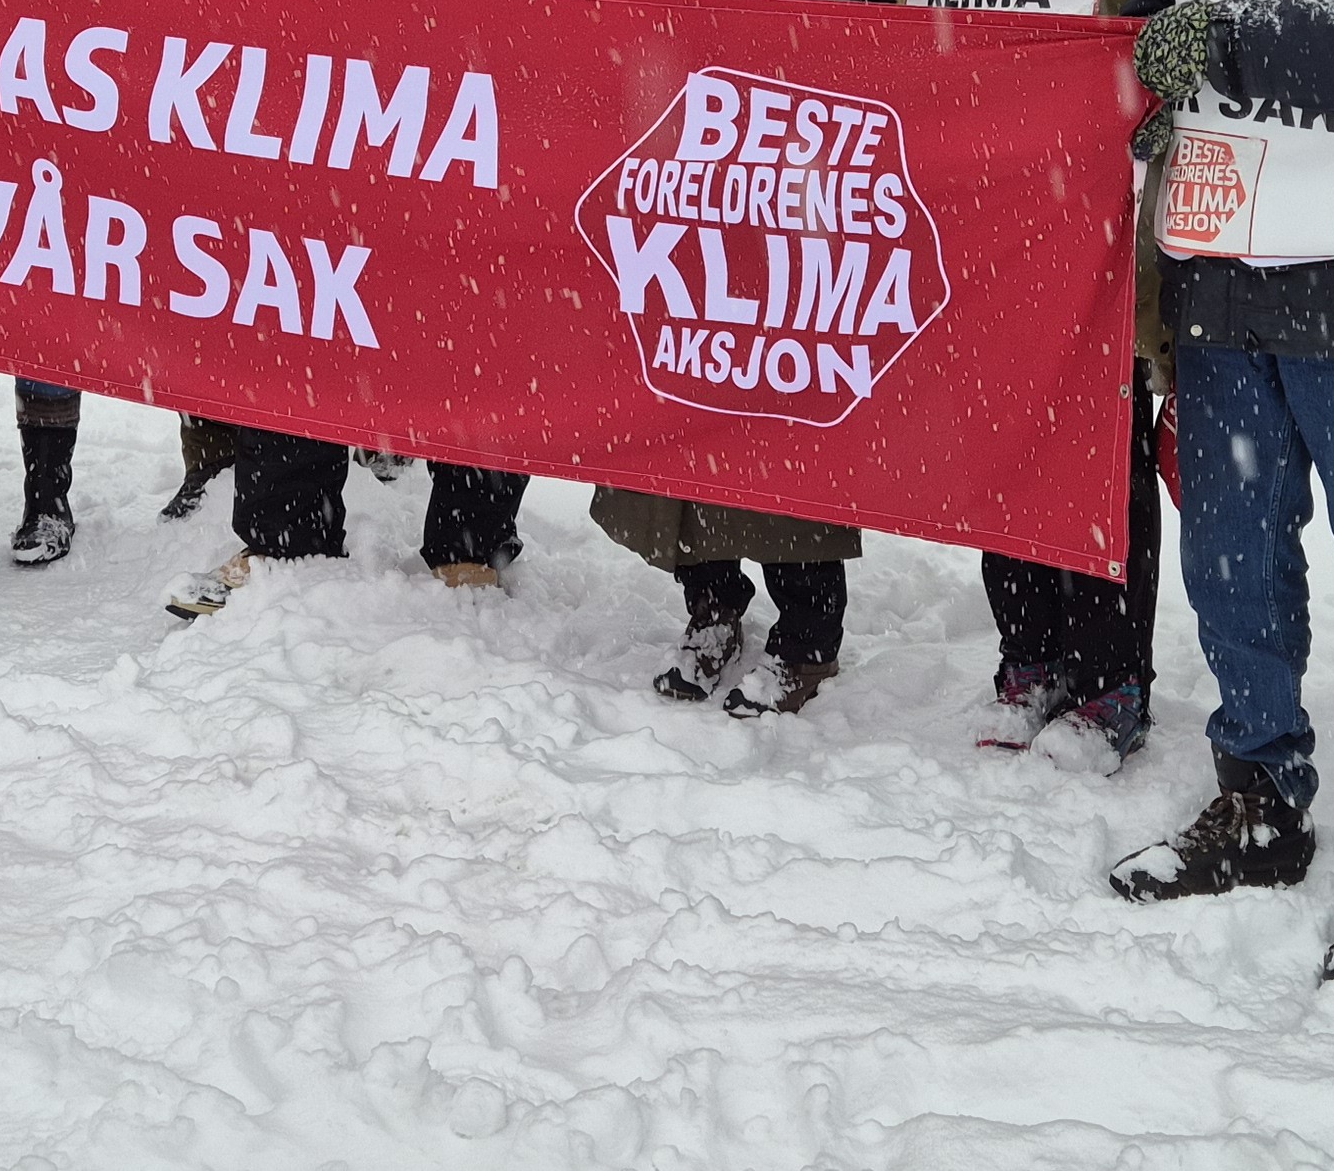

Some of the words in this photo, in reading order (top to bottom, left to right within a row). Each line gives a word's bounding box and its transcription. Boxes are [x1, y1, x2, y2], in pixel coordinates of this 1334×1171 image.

[148, 35, 499, 189] KLIMA
[675, 71, 888, 167] BESTE
[1177, 139, 1227, 165] BESTE
[616, 157, 908, 239] FORELDRENES
[1166, 181, 1239, 213] KLIMA
[169, 214, 381, 349] SAK
[605, 214, 920, 336] KLIMA
[652, 325, 873, 399] AKSJON
